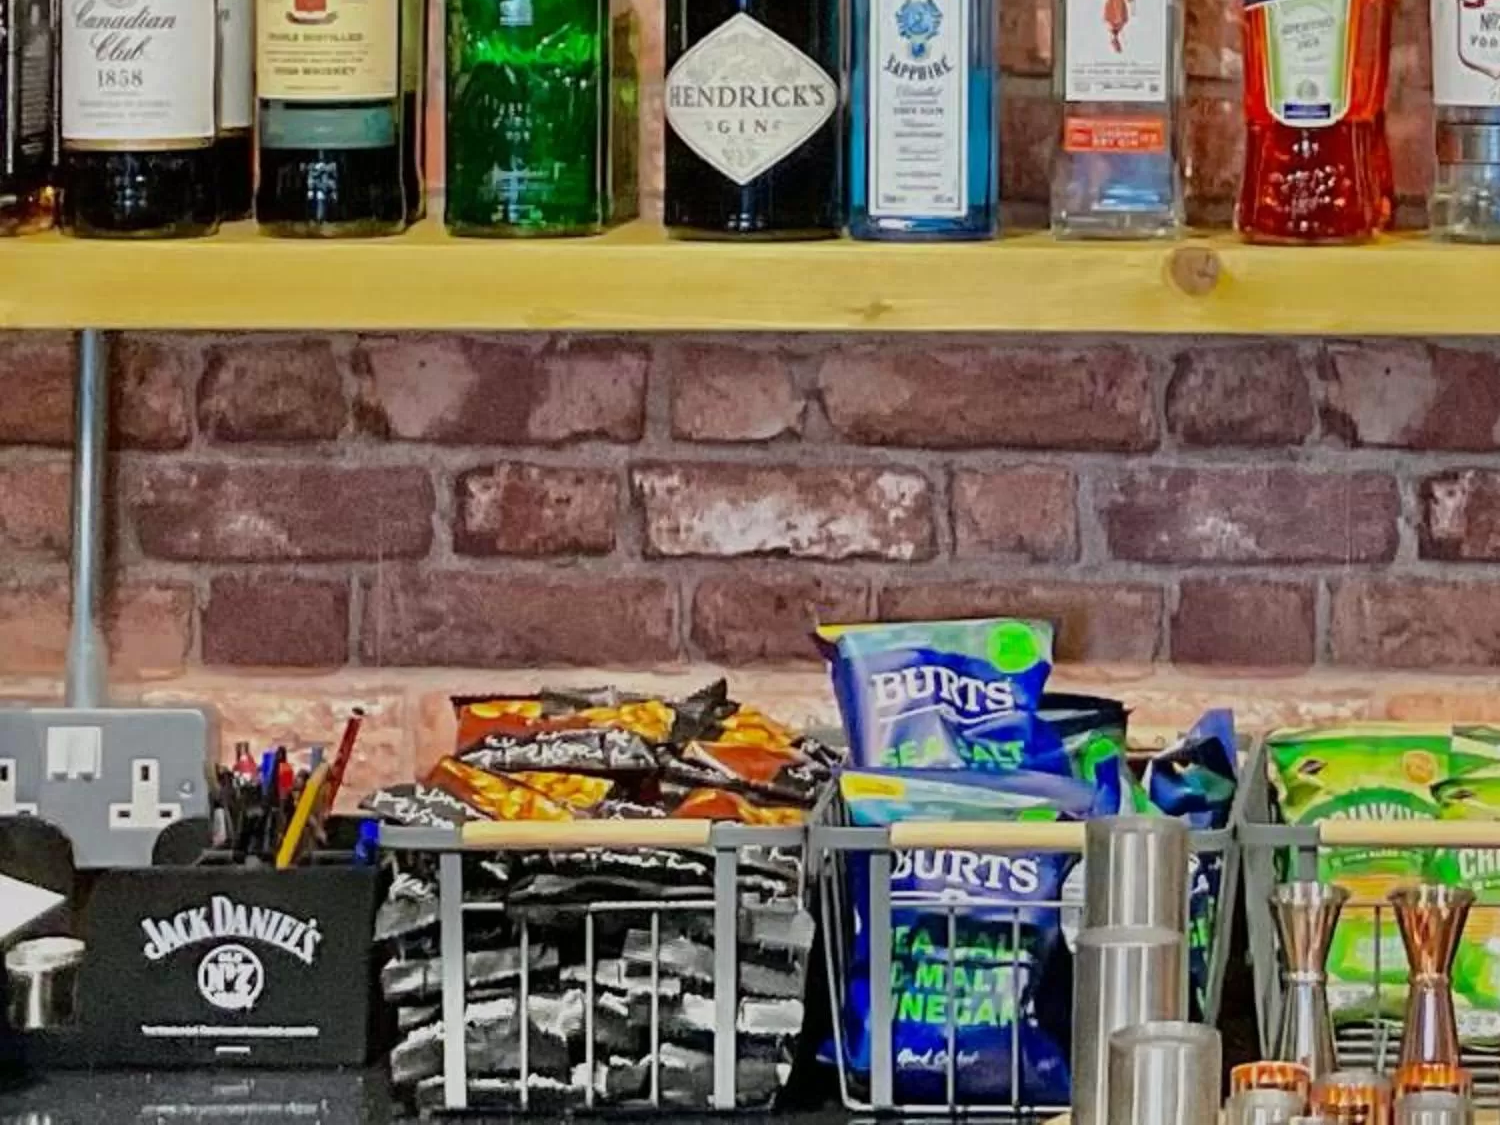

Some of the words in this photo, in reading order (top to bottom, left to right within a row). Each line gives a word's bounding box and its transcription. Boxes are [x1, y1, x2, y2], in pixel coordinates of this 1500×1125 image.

[90, 31, 152, 62] Club
[97, 68, 144, 88] 1858
[883, 52, 955, 81] SAPPHIRE
[669, 84, 826, 108] HENDRICK'S
[716, 119, 768, 135] GIN
[871, 665, 1014, 712] BURTS
[141, 906, 213, 960] JACK
[211, 895, 322, 965] DANIEL'S
[892, 926, 935, 956] EA
